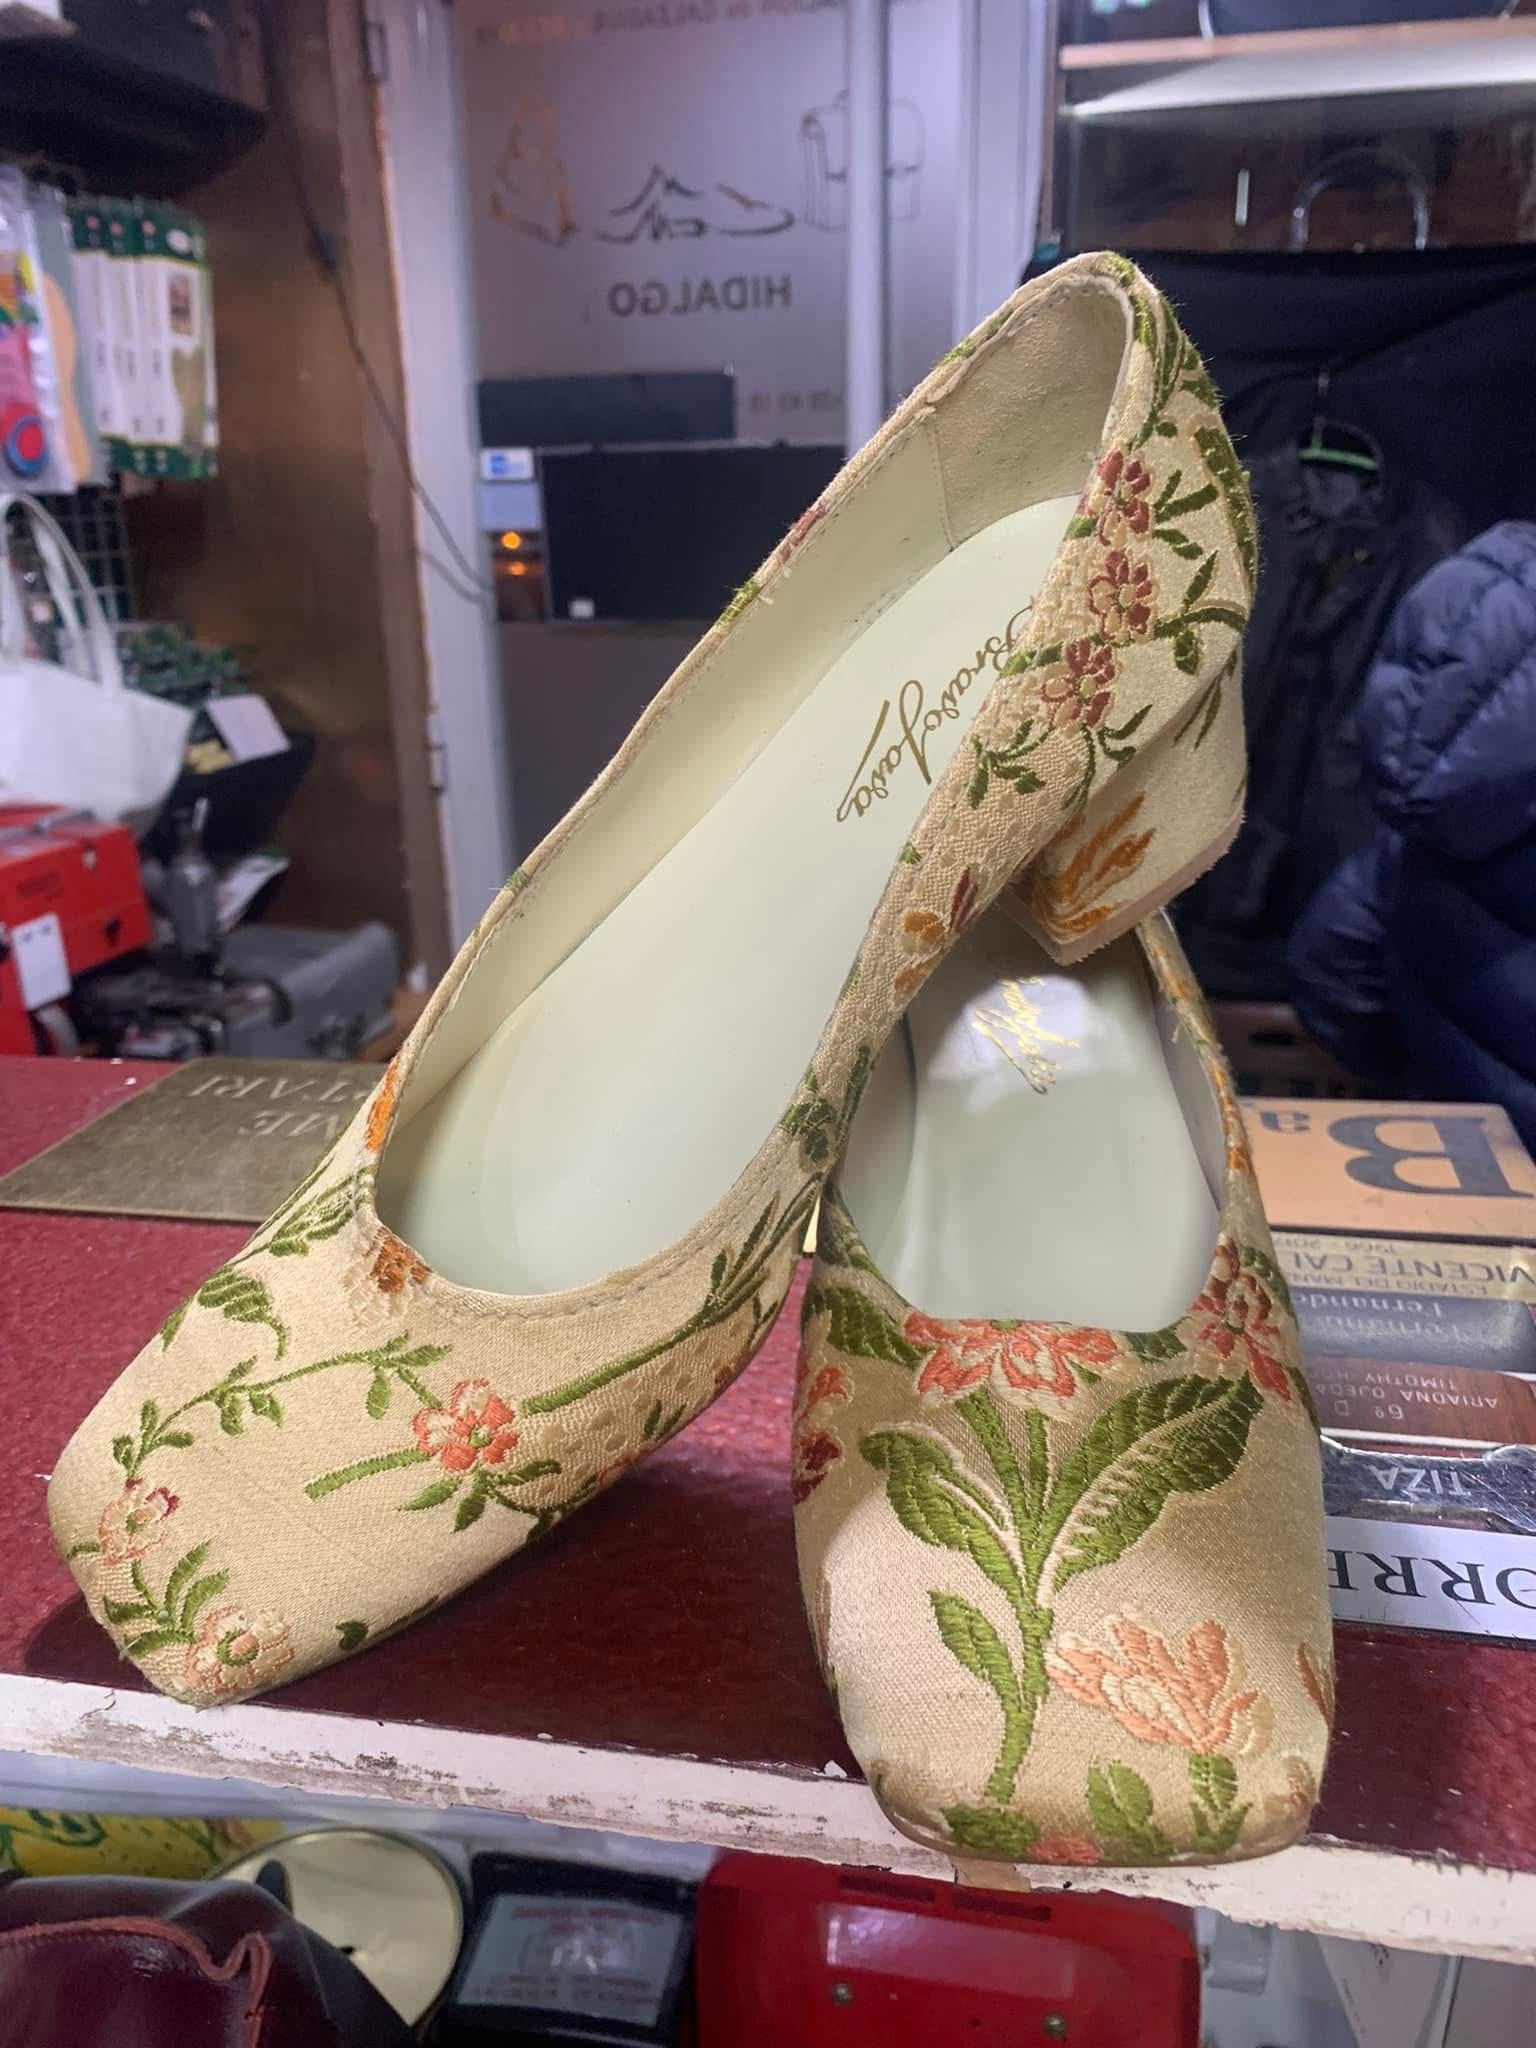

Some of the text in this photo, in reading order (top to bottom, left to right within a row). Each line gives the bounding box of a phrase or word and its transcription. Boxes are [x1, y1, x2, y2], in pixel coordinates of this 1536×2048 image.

[1366, 1254, 1536, 1288] VICENTE
[1364, 1372, 1458, 1389] TIMOTHY
[1399, 1389, 1498, 1408] ARIADNA
